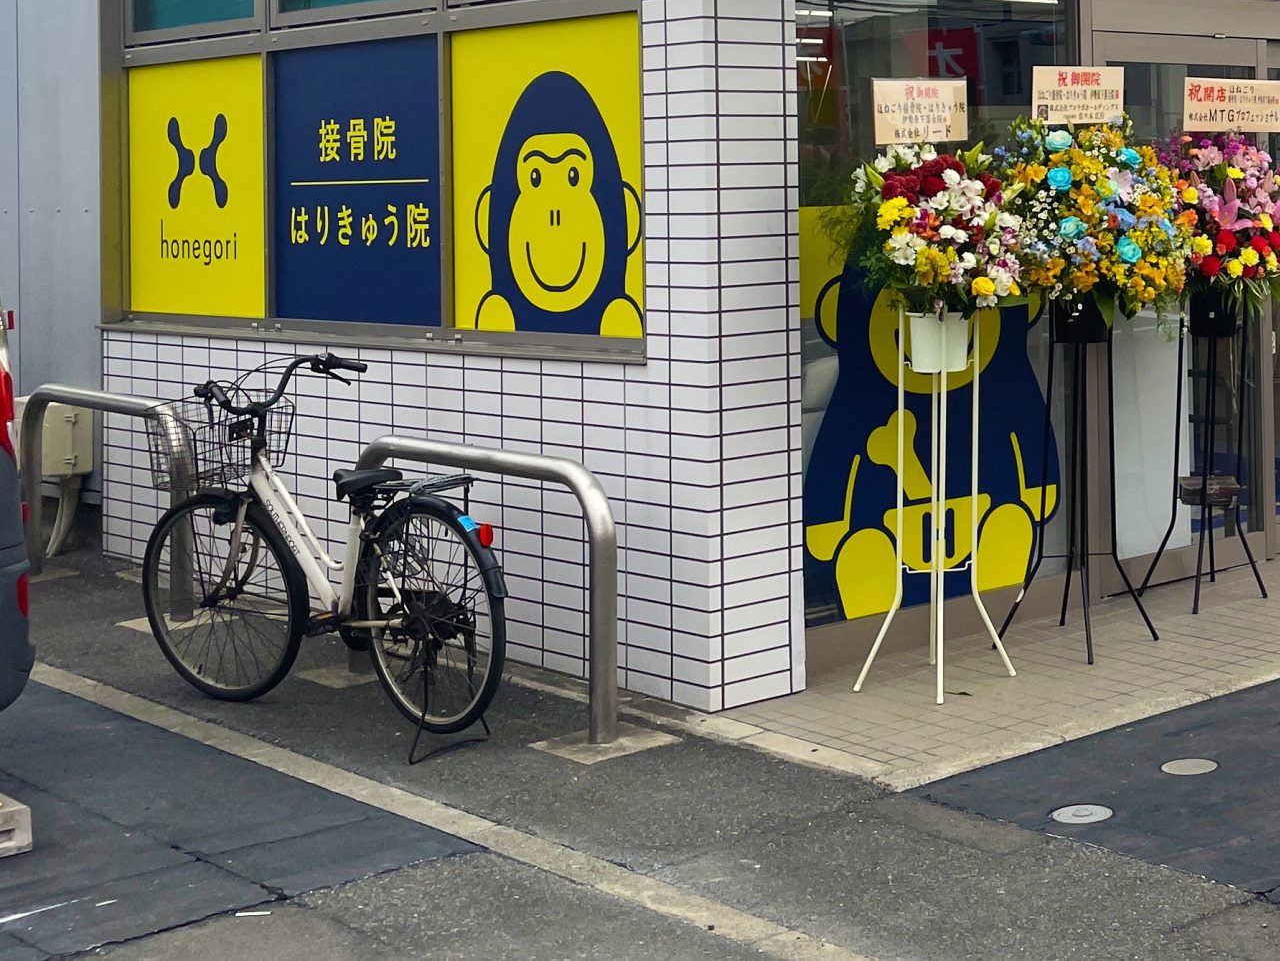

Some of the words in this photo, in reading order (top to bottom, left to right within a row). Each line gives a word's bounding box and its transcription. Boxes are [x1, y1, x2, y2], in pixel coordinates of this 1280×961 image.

[318, 115, 397, 163] 接骨院
[160, 218, 238, 267] honegori
[291, 202, 431, 249] はりきゅう院
